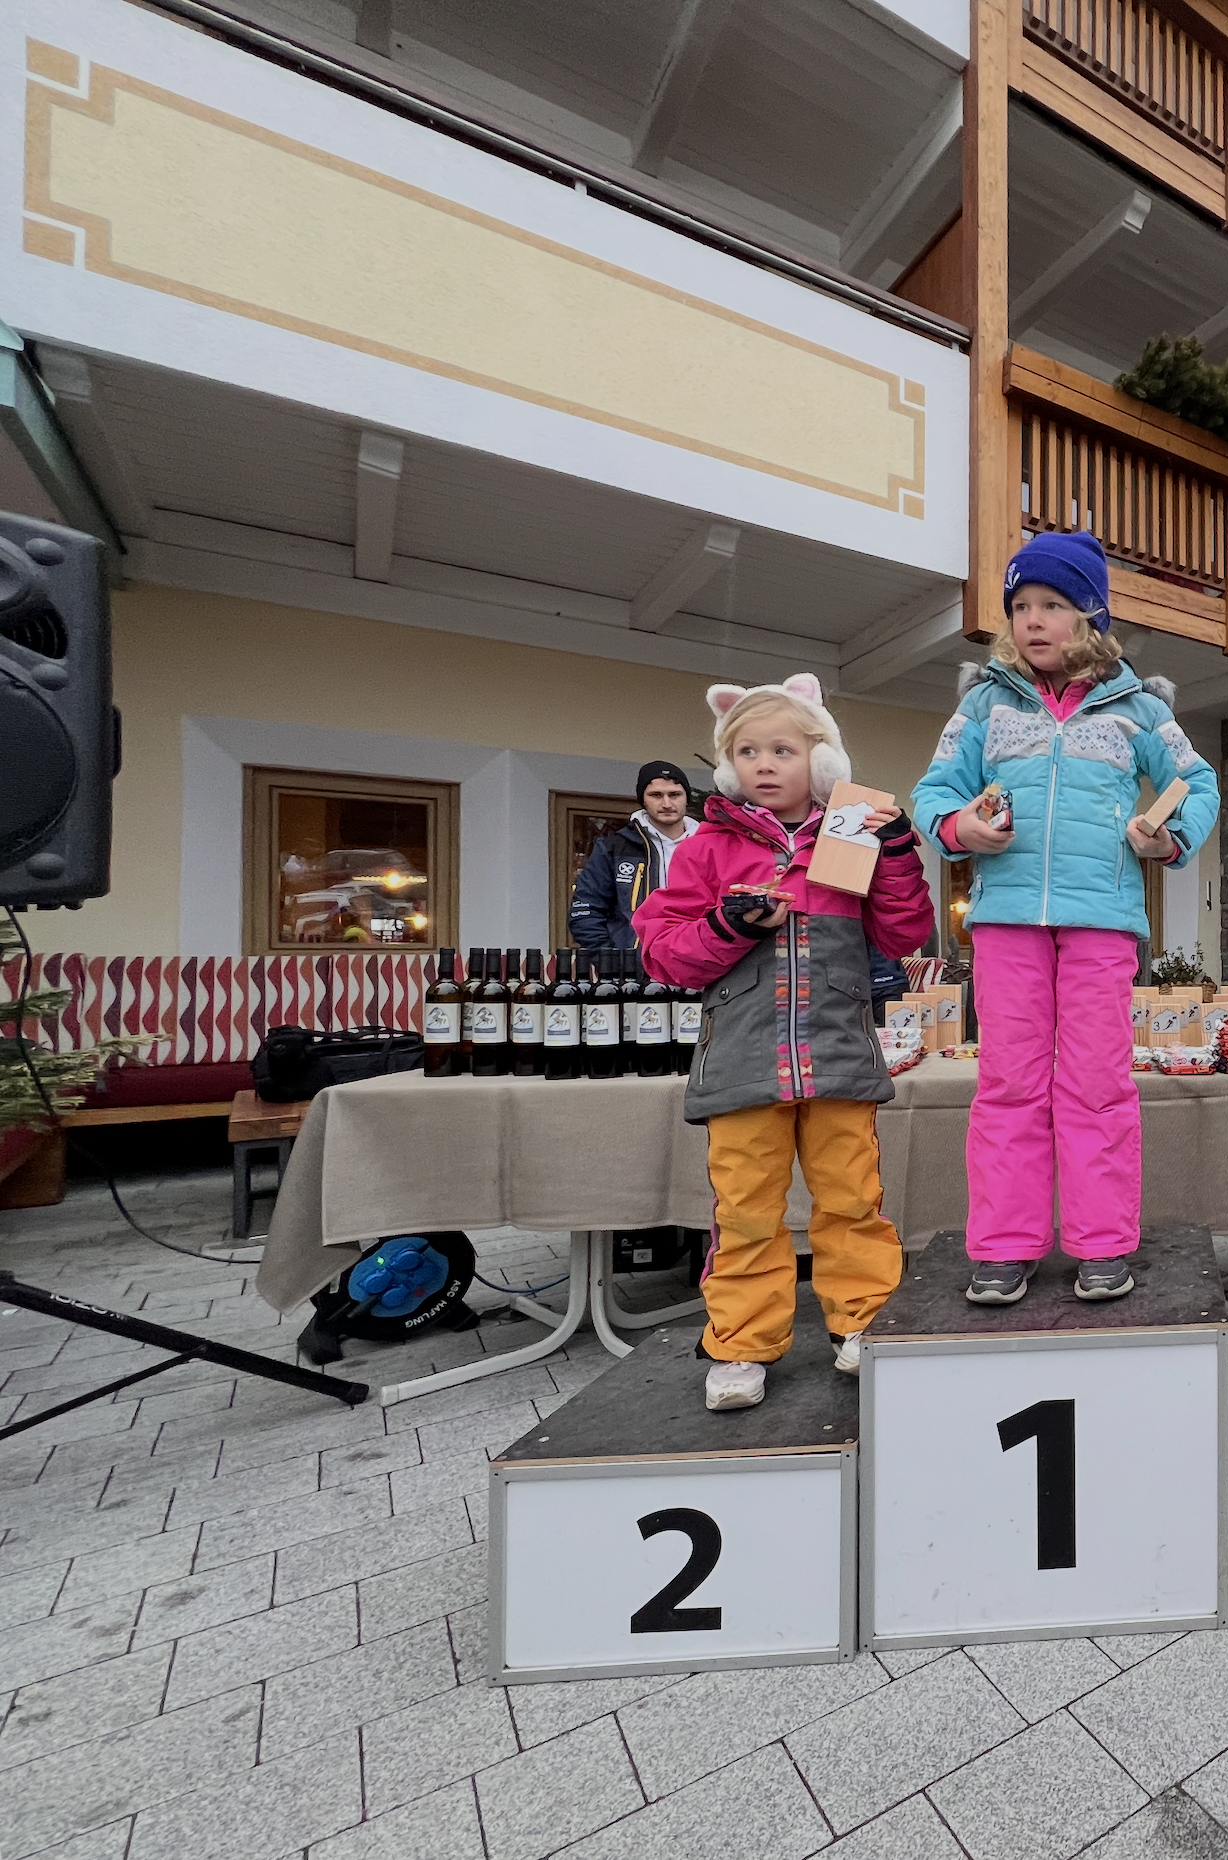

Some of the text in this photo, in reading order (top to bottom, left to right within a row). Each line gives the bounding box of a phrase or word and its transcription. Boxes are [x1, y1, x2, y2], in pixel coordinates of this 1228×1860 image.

[829, 815, 845, 834] 2
[1153, 1021, 1160, 1032] 3
[1205, 1020, 1212, 1031] 3
[405, 1279, 462, 1329] ASC HAFLING
[997, 1399, 1076, 1570] 1
[631, 1508, 721, 1633] 2
